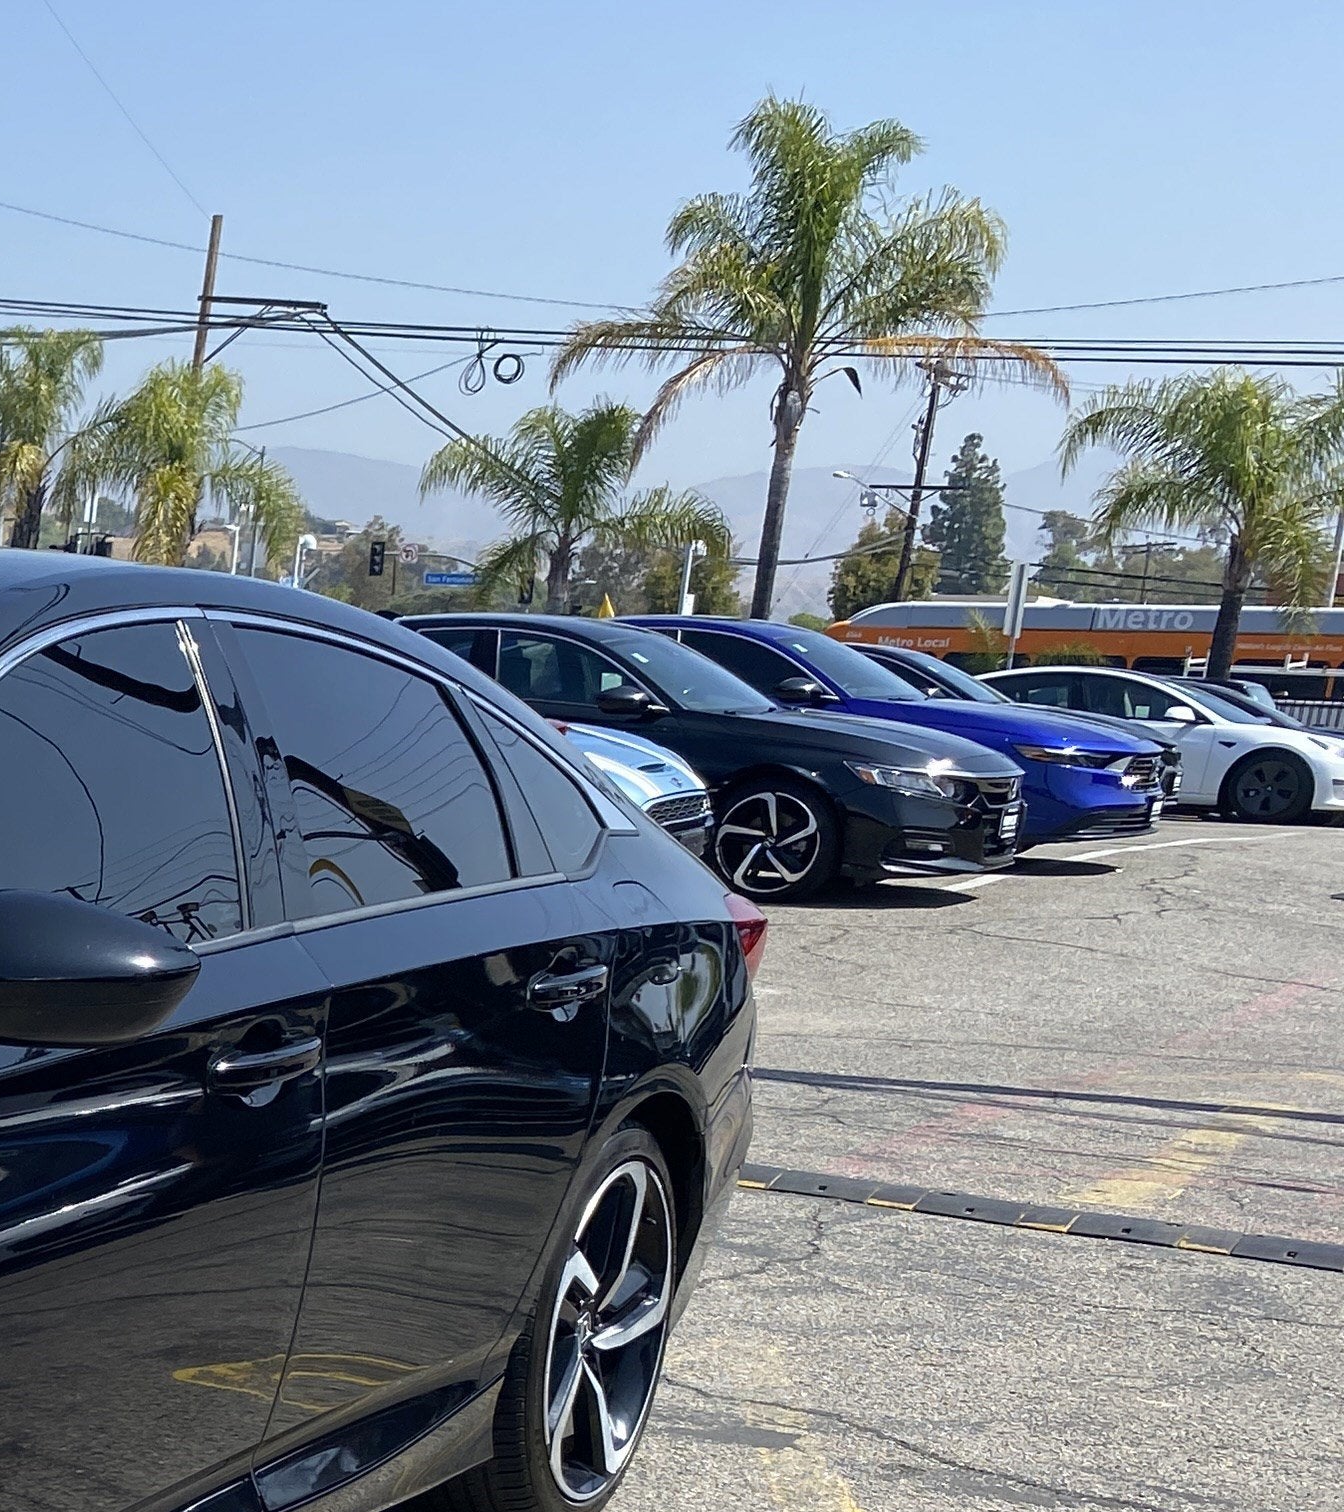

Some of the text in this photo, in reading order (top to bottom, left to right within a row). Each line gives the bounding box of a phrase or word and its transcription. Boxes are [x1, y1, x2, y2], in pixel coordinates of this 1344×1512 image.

[1094, 608, 1194, 631] Metro
[878, 636, 950, 648] Metro Local
